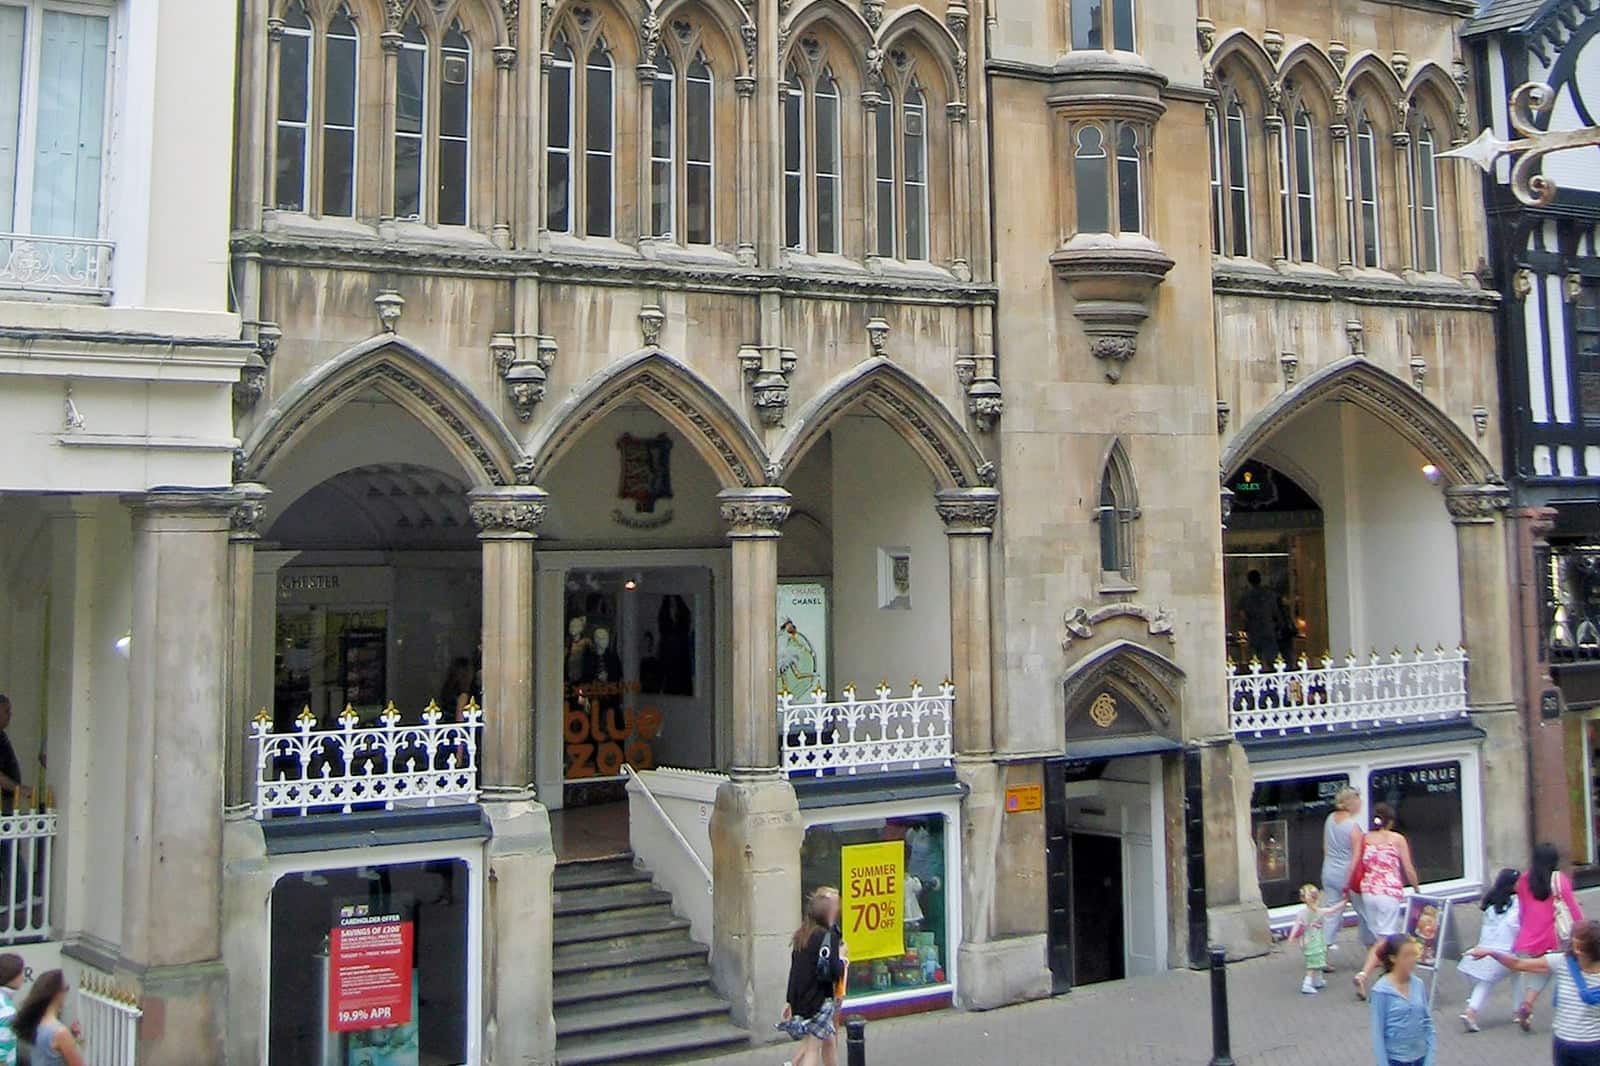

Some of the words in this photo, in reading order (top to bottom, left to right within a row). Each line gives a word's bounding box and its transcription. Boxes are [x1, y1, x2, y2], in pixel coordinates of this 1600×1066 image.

[792, 598, 823, 606] CHANEL
[563, 701, 664, 743] blue
[567, 742, 652, 777] zoo
[1409, 767, 1456, 783] VENUE
[851, 864, 896, 878] SUMMER
[851, 876, 896, 898] SALE
[851, 902, 895, 933] 70%
[880, 919, 895, 928] OFF
[341, 927, 370, 937] SAVINGS
[372, 926, 381, 935] OF
[339, 1009, 369, 1022] 19.9%
[370, 1007, 391, 1019] APR
